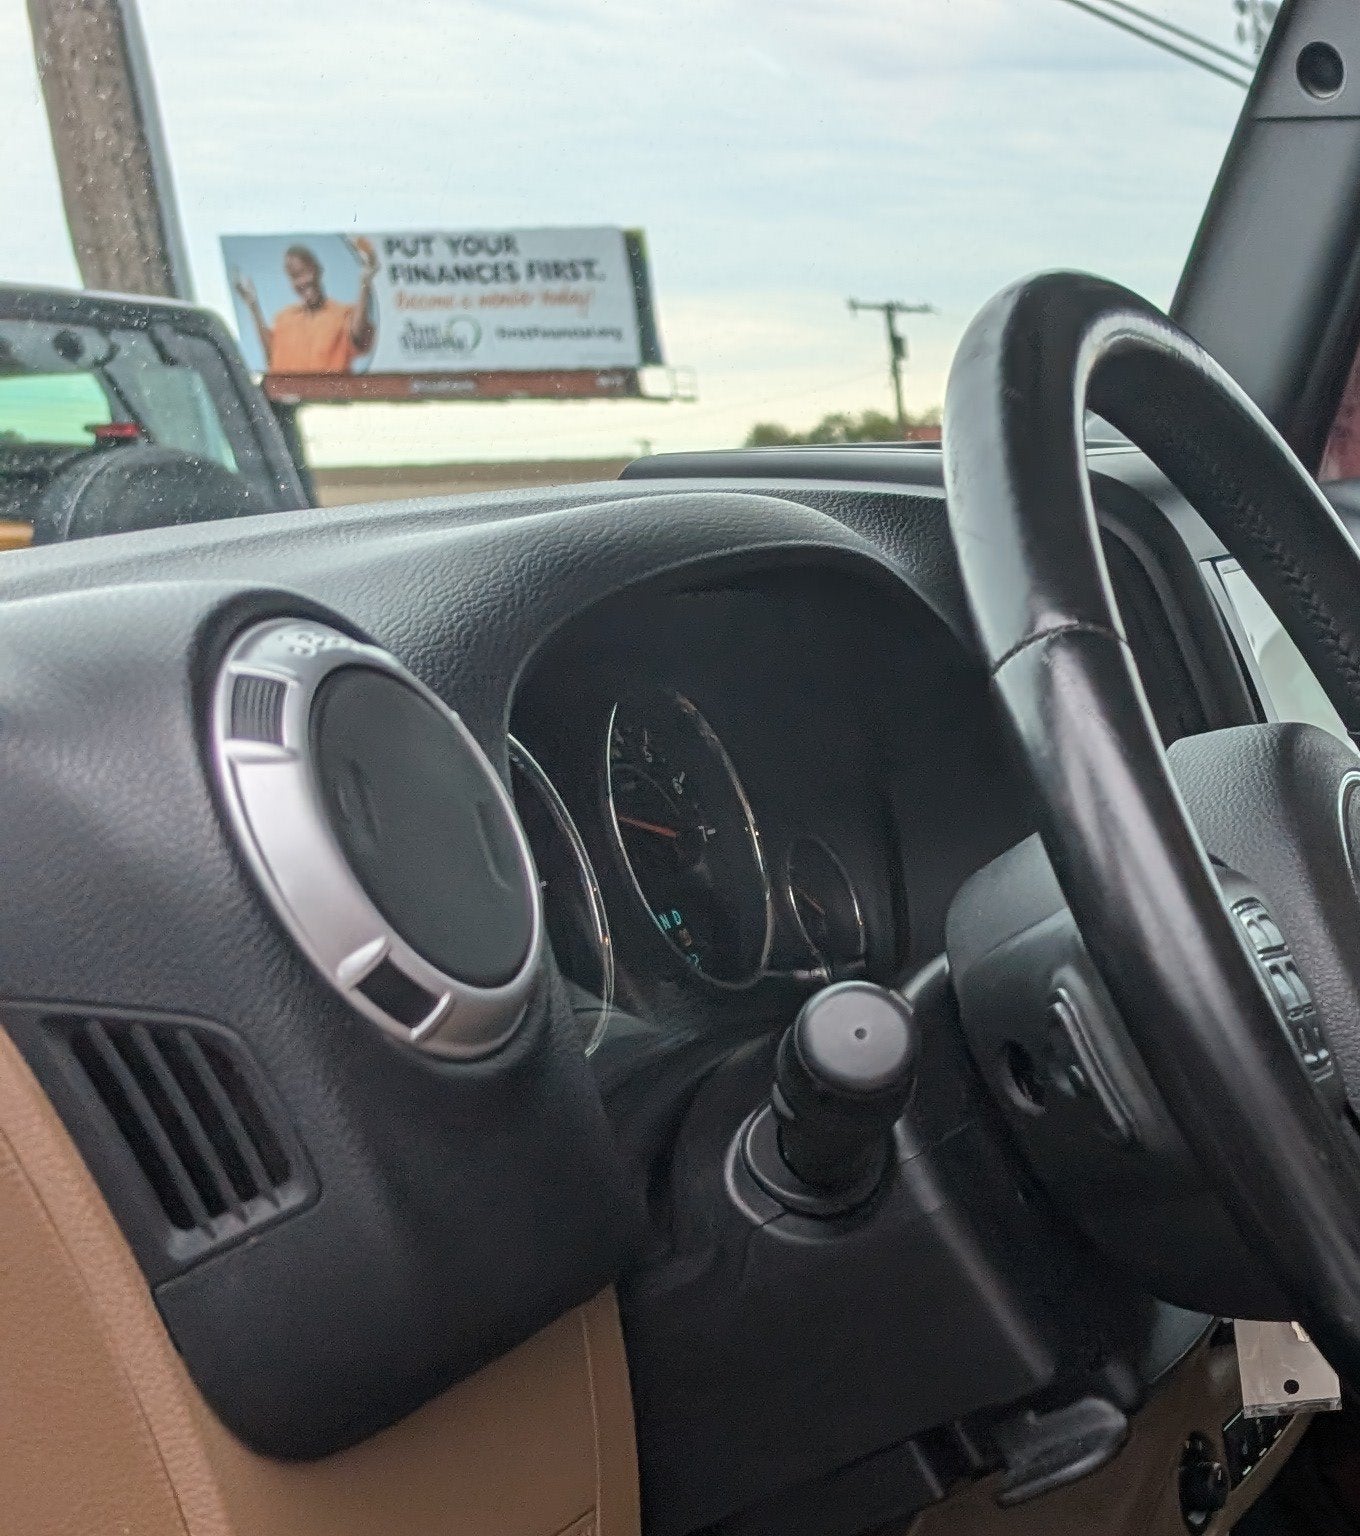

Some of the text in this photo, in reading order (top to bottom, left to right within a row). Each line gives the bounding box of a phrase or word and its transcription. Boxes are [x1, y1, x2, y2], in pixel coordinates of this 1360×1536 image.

[384, 233, 519, 259] PUT YOUR
[387, 260, 521, 285] FINANCES
